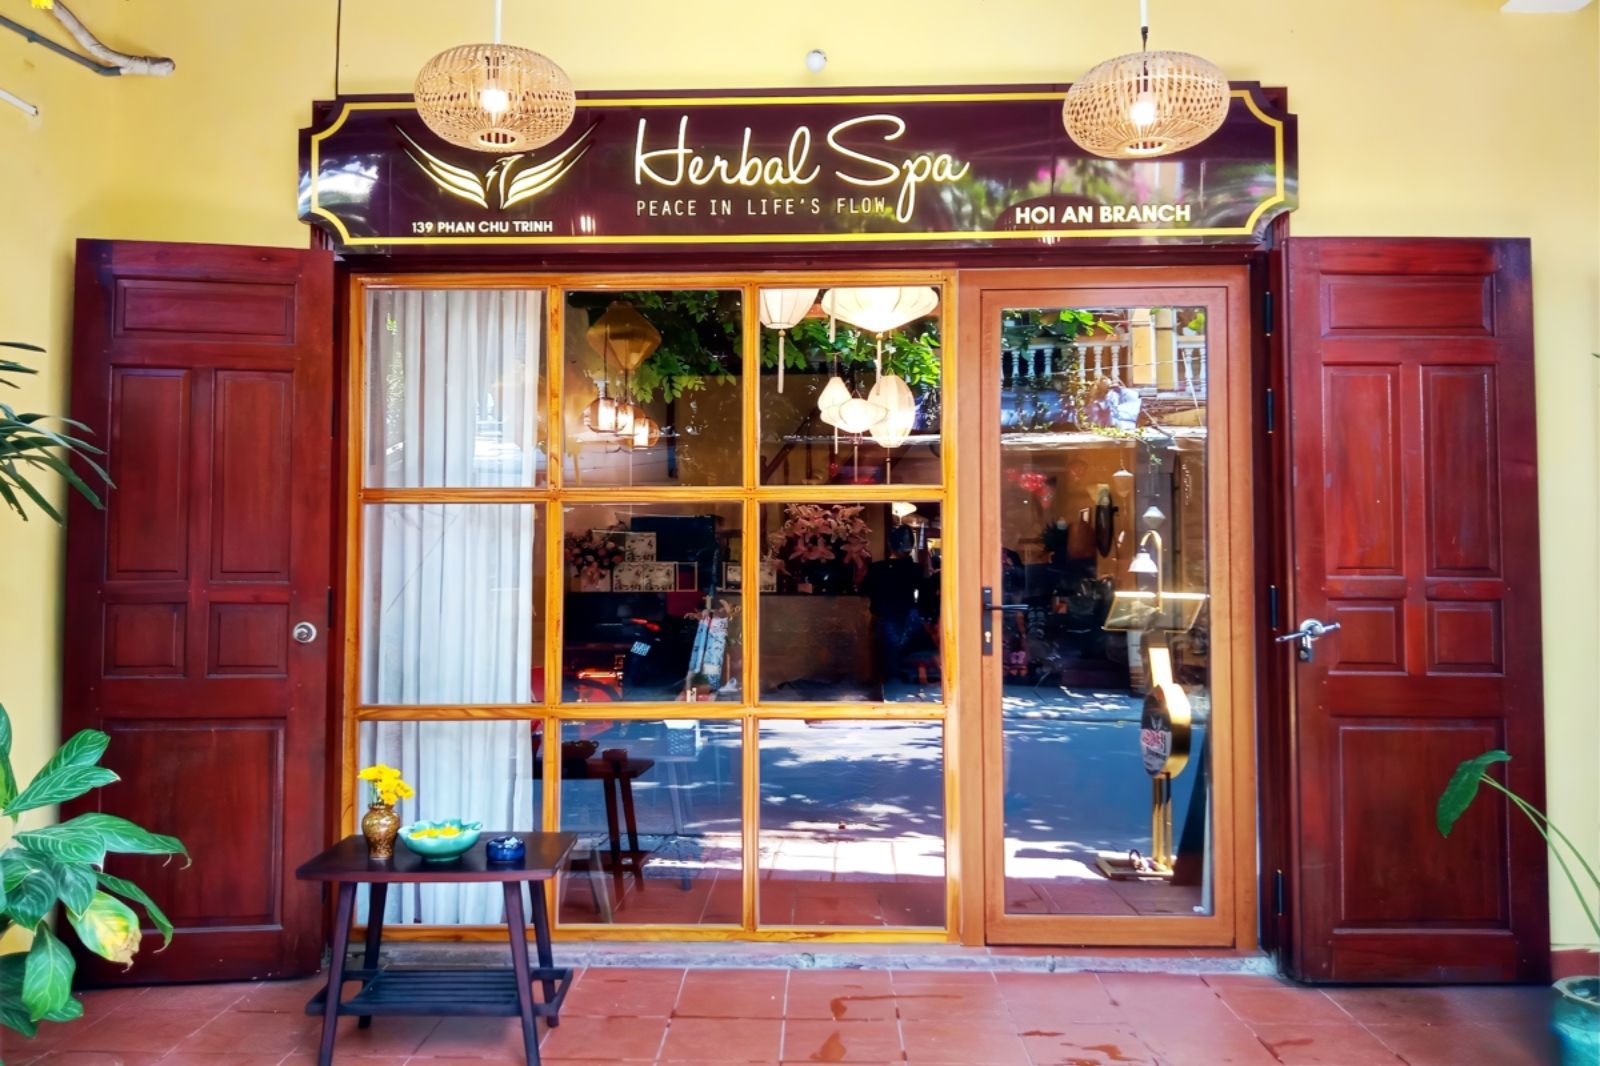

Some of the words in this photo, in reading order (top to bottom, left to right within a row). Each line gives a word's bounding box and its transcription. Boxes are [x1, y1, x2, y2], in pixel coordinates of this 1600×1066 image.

[634, 115, 821, 186] Herbal
[827, 114, 970, 223] Spa
[636, 200, 697, 216] PEACE
[710, 200, 731, 215] IN
[747, 198, 820, 214] LIFE'S
[836, 197, 886, 213] FLOW
[1015, 206, 1056, 224] HOI
[1061, 205, 1093, 223] AN
[1099, 204, 1192, 222] BRANCH
[411, 222, 433, 233] 139
[437, 221, 475, 233] PHAN
[478, 221, 509, 232] CHU
[512, 220, 553, 232] TRINH
